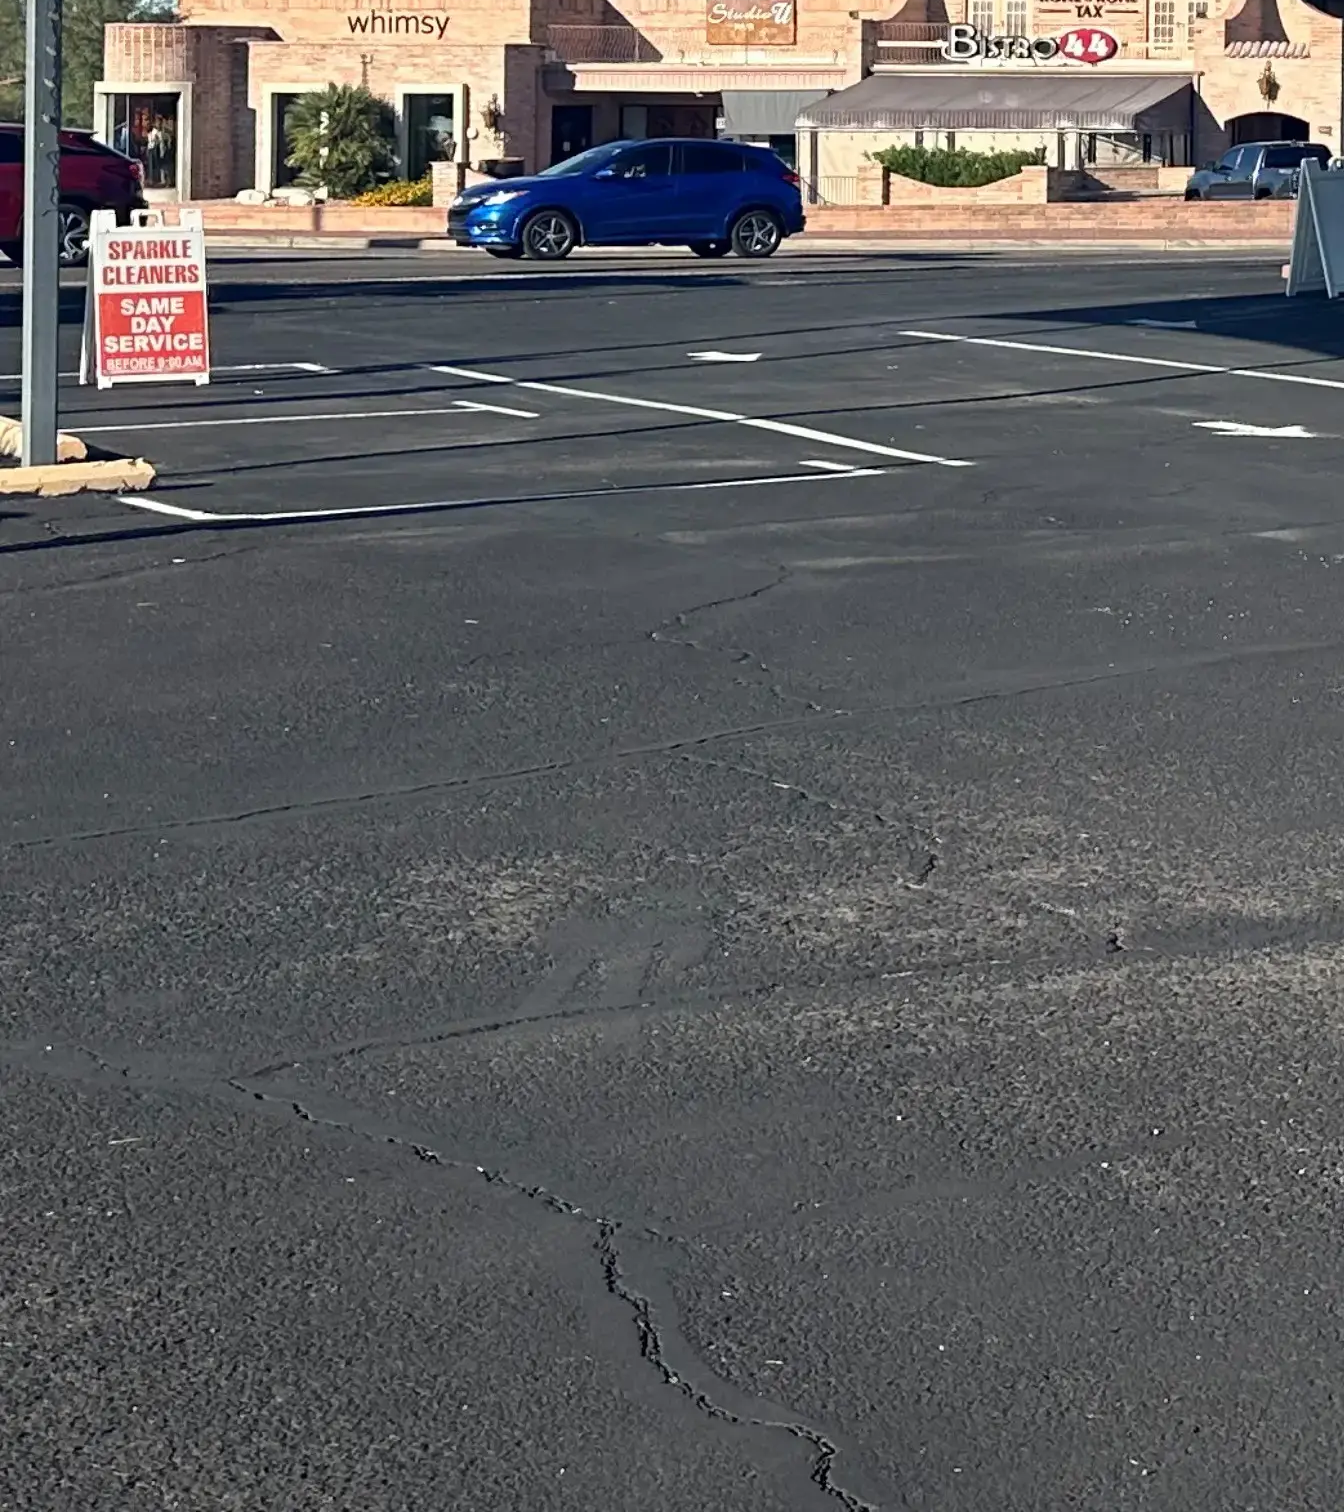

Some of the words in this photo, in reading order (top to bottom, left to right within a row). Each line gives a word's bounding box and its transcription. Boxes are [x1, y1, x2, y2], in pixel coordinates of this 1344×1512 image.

[708, 3, 772, 24] Studio
[771, 2, 793, 24] U
[1075, 5, 1103, 18] TAX
[347, 8, 450, 40] whimsy
[1064, 33, 1109, 57] 44
[108, 239, 192, 260] SPARKLE
[102, 264, 200, 286] CLEANERS
[120, 296, 185, 316] SAME
[131, 316, 176, 333] DAY
[104, 333, 204, 354] SERVICE
[106, 357, 155, 371] BEFORE
